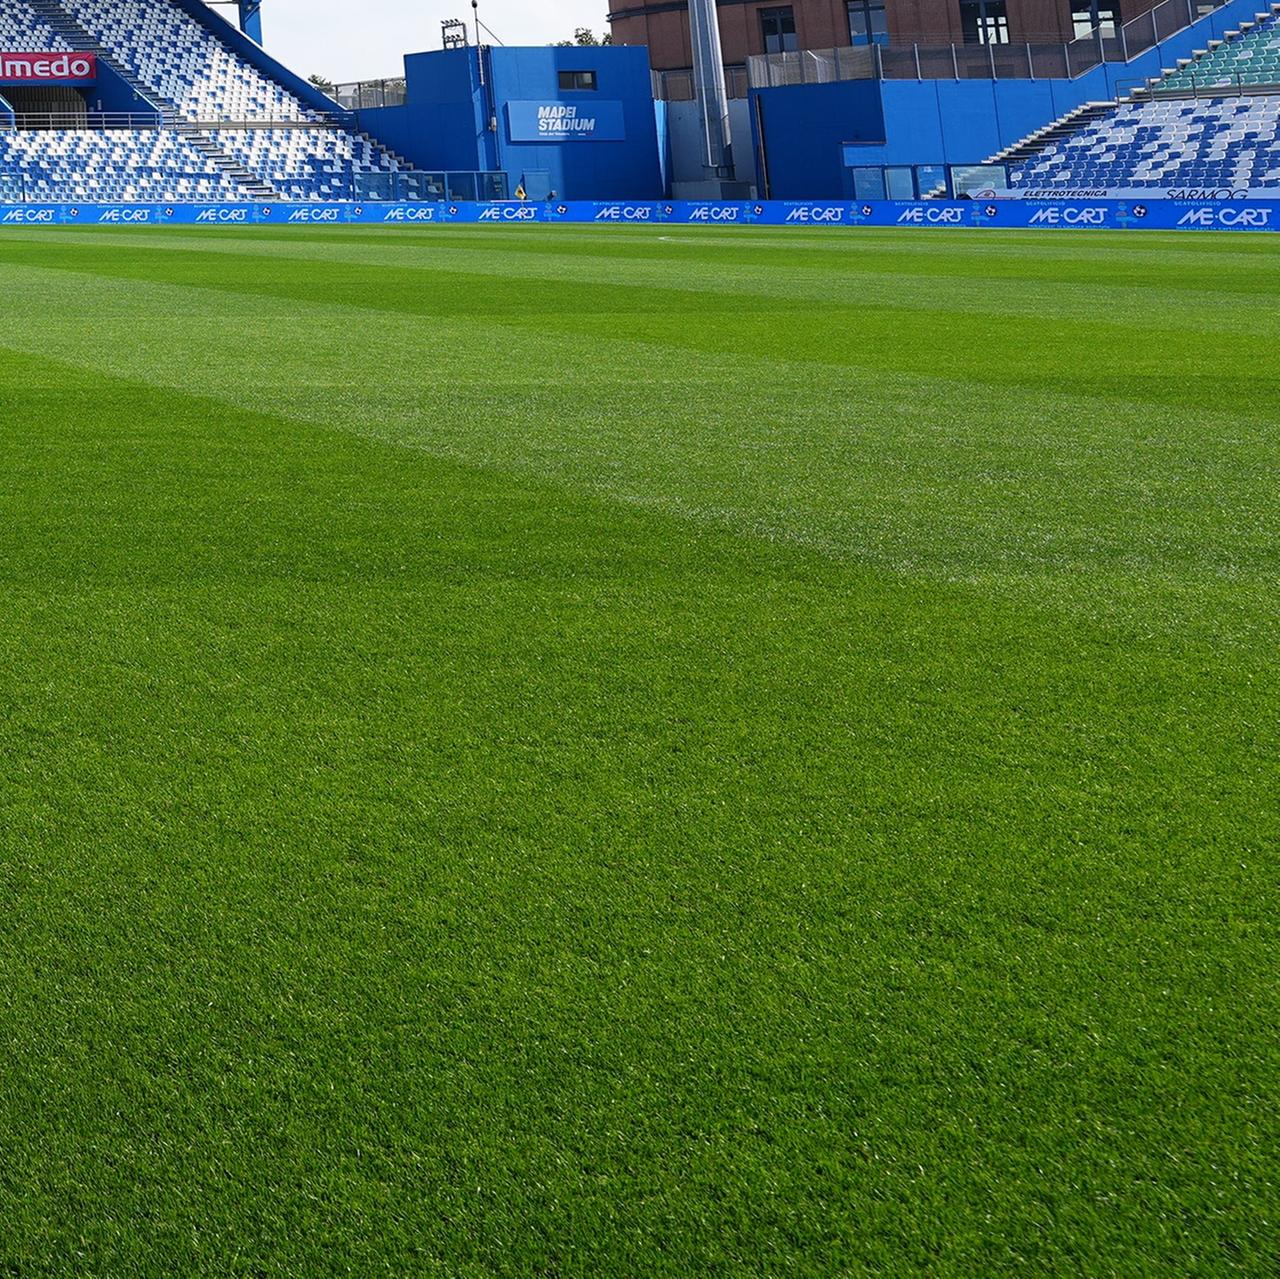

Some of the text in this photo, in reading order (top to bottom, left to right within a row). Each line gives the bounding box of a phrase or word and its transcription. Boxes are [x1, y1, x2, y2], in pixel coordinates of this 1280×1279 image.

[538, 106, 577, 118] MAPEI
[538, 118, 596, 131] STADIUM
[1166, 189, 1249, 200] SARMOG
